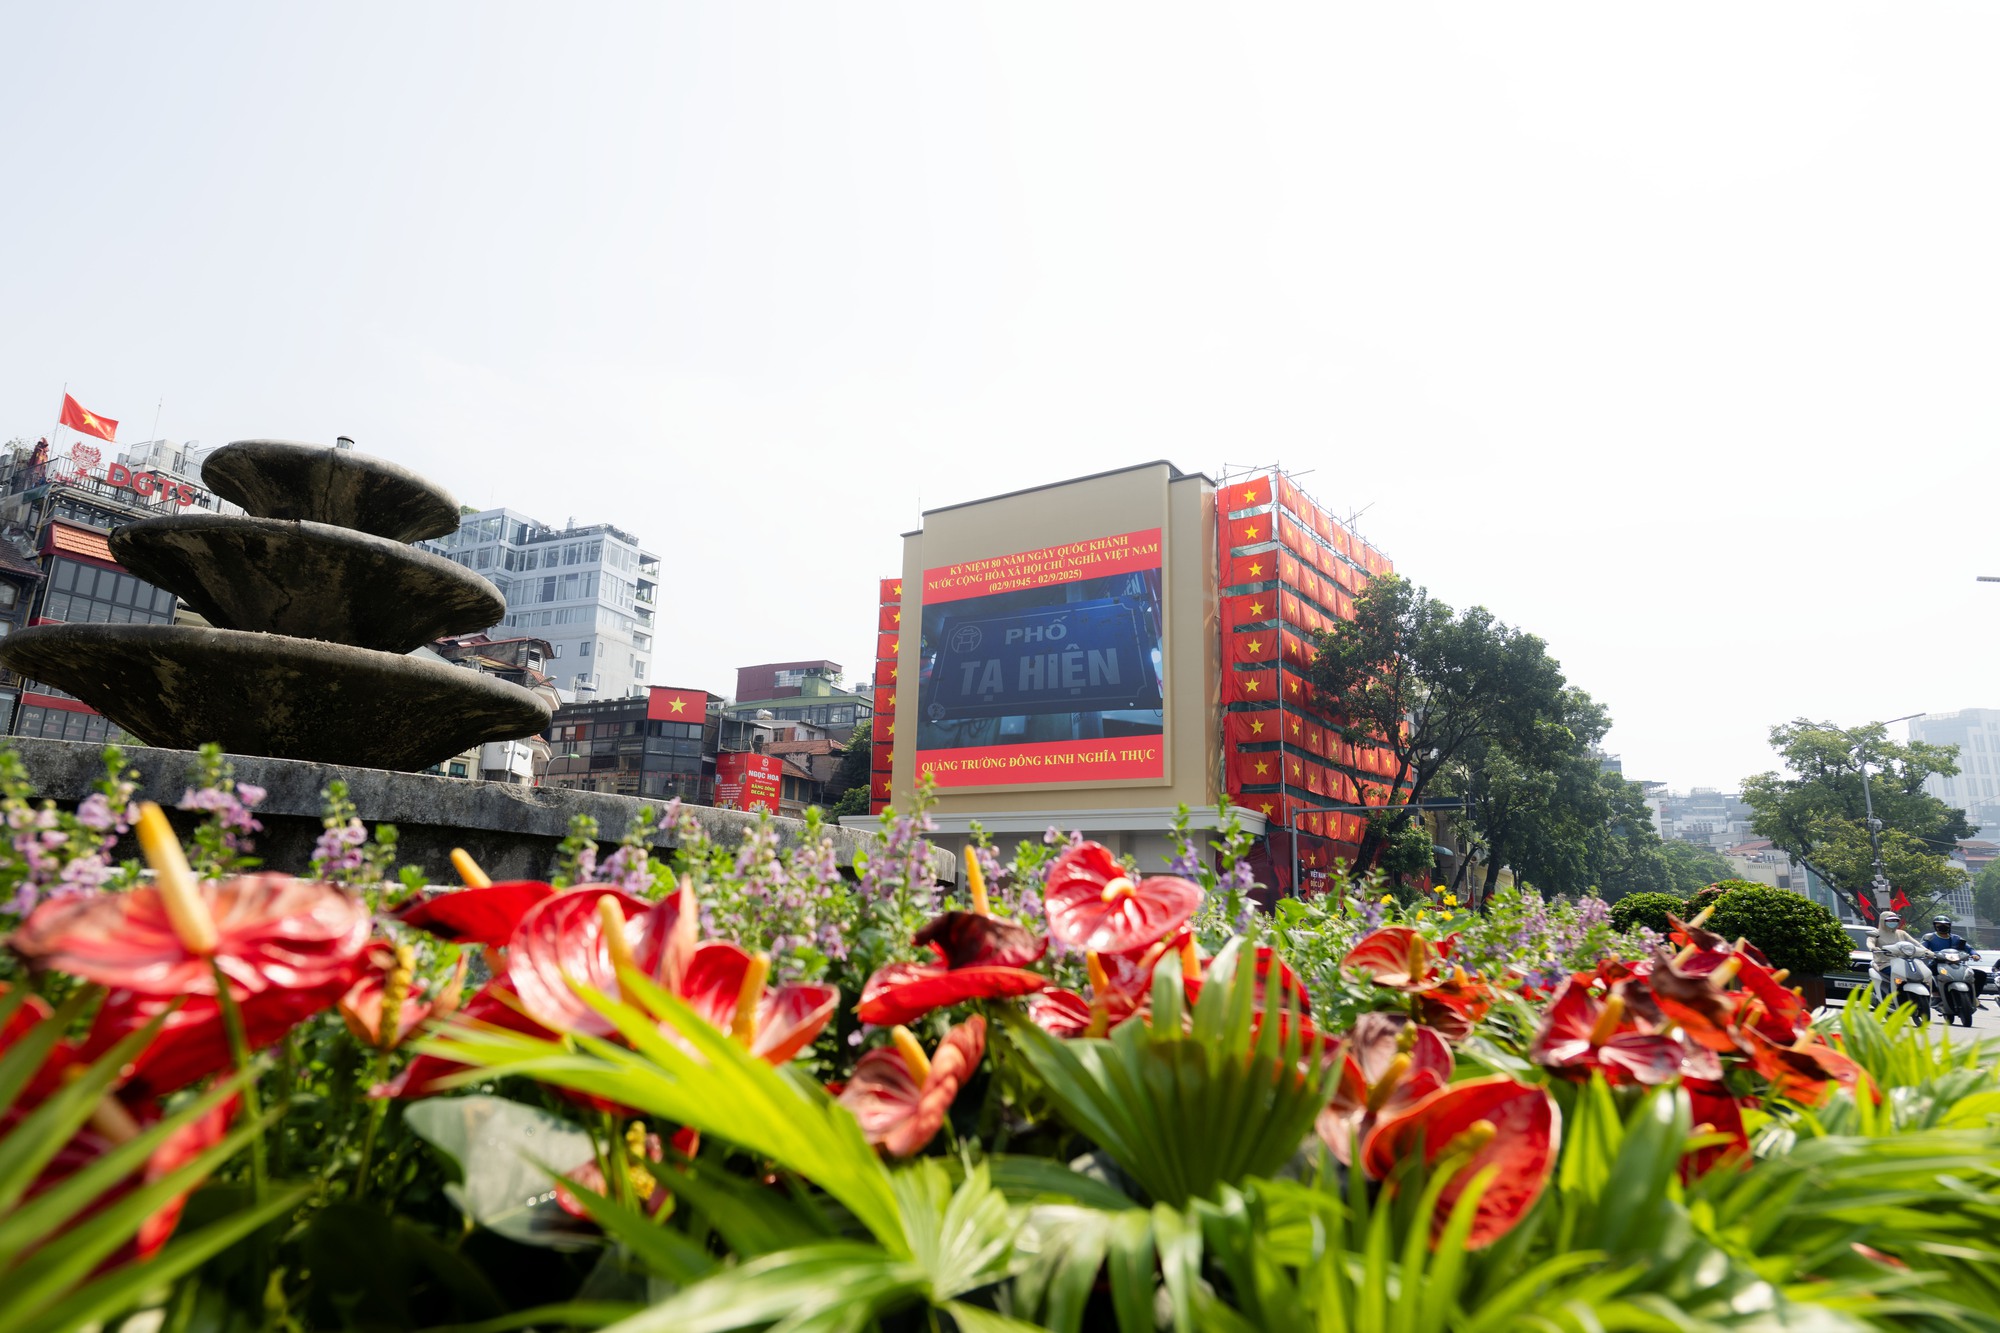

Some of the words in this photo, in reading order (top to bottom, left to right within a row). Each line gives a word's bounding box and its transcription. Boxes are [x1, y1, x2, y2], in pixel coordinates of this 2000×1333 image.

[106, 462, 197, 507] DGTS
[928, 577, 955, 590] NƯỚC
[956, 574, 983, 586] CỘNG
[985, 569, 1006, 581] HÒA
[1008, 566, 1021, 577] XÃ
[1023, 563, 1042, 575] HỘI
[1044, 558, 1066, 571] CHỦ
[1068, 552, 1101, 567] NGHĨA
[1104, 548, 1130, 561] VIỆT
[1132, 543, 1158, 556] NAM
[950, 563, 964, 576] KỶ
[965, 560, 989, 573] NIỆM
[991, 559, 1001, 569] 80
[1003, 554, 1025, 566] NĂM
[1027, 548, 1056, 561] NGÀY
[1057, 542, 1087, 557] QUỐC
[1089, 536, 1129, 551] KHÁNH
[989, 577, 1031, 593] (02/9/1945
[1038, 569, 1082, 584] 02/9/2025)
[1004, 615, 1068, 645] PHỐ
[960, 658, 1004, 702] TẠ
[1018, 643, 1121, 696] HIỆN
[748, 770, 766, 779] NGỌC
[767, 774, 779, 782] HOA
[921, 759, 958, 772] QUẢNG
[961, 756, 1006, 769] TRƯỜNG
[1009, 754, 1041, 767] ĐÔNG
[1044, 754, 1074, 765] KINH
[1077, 749, 1117, 763] NGHĨA
[1120, 749, 1155, 763] THỤC
